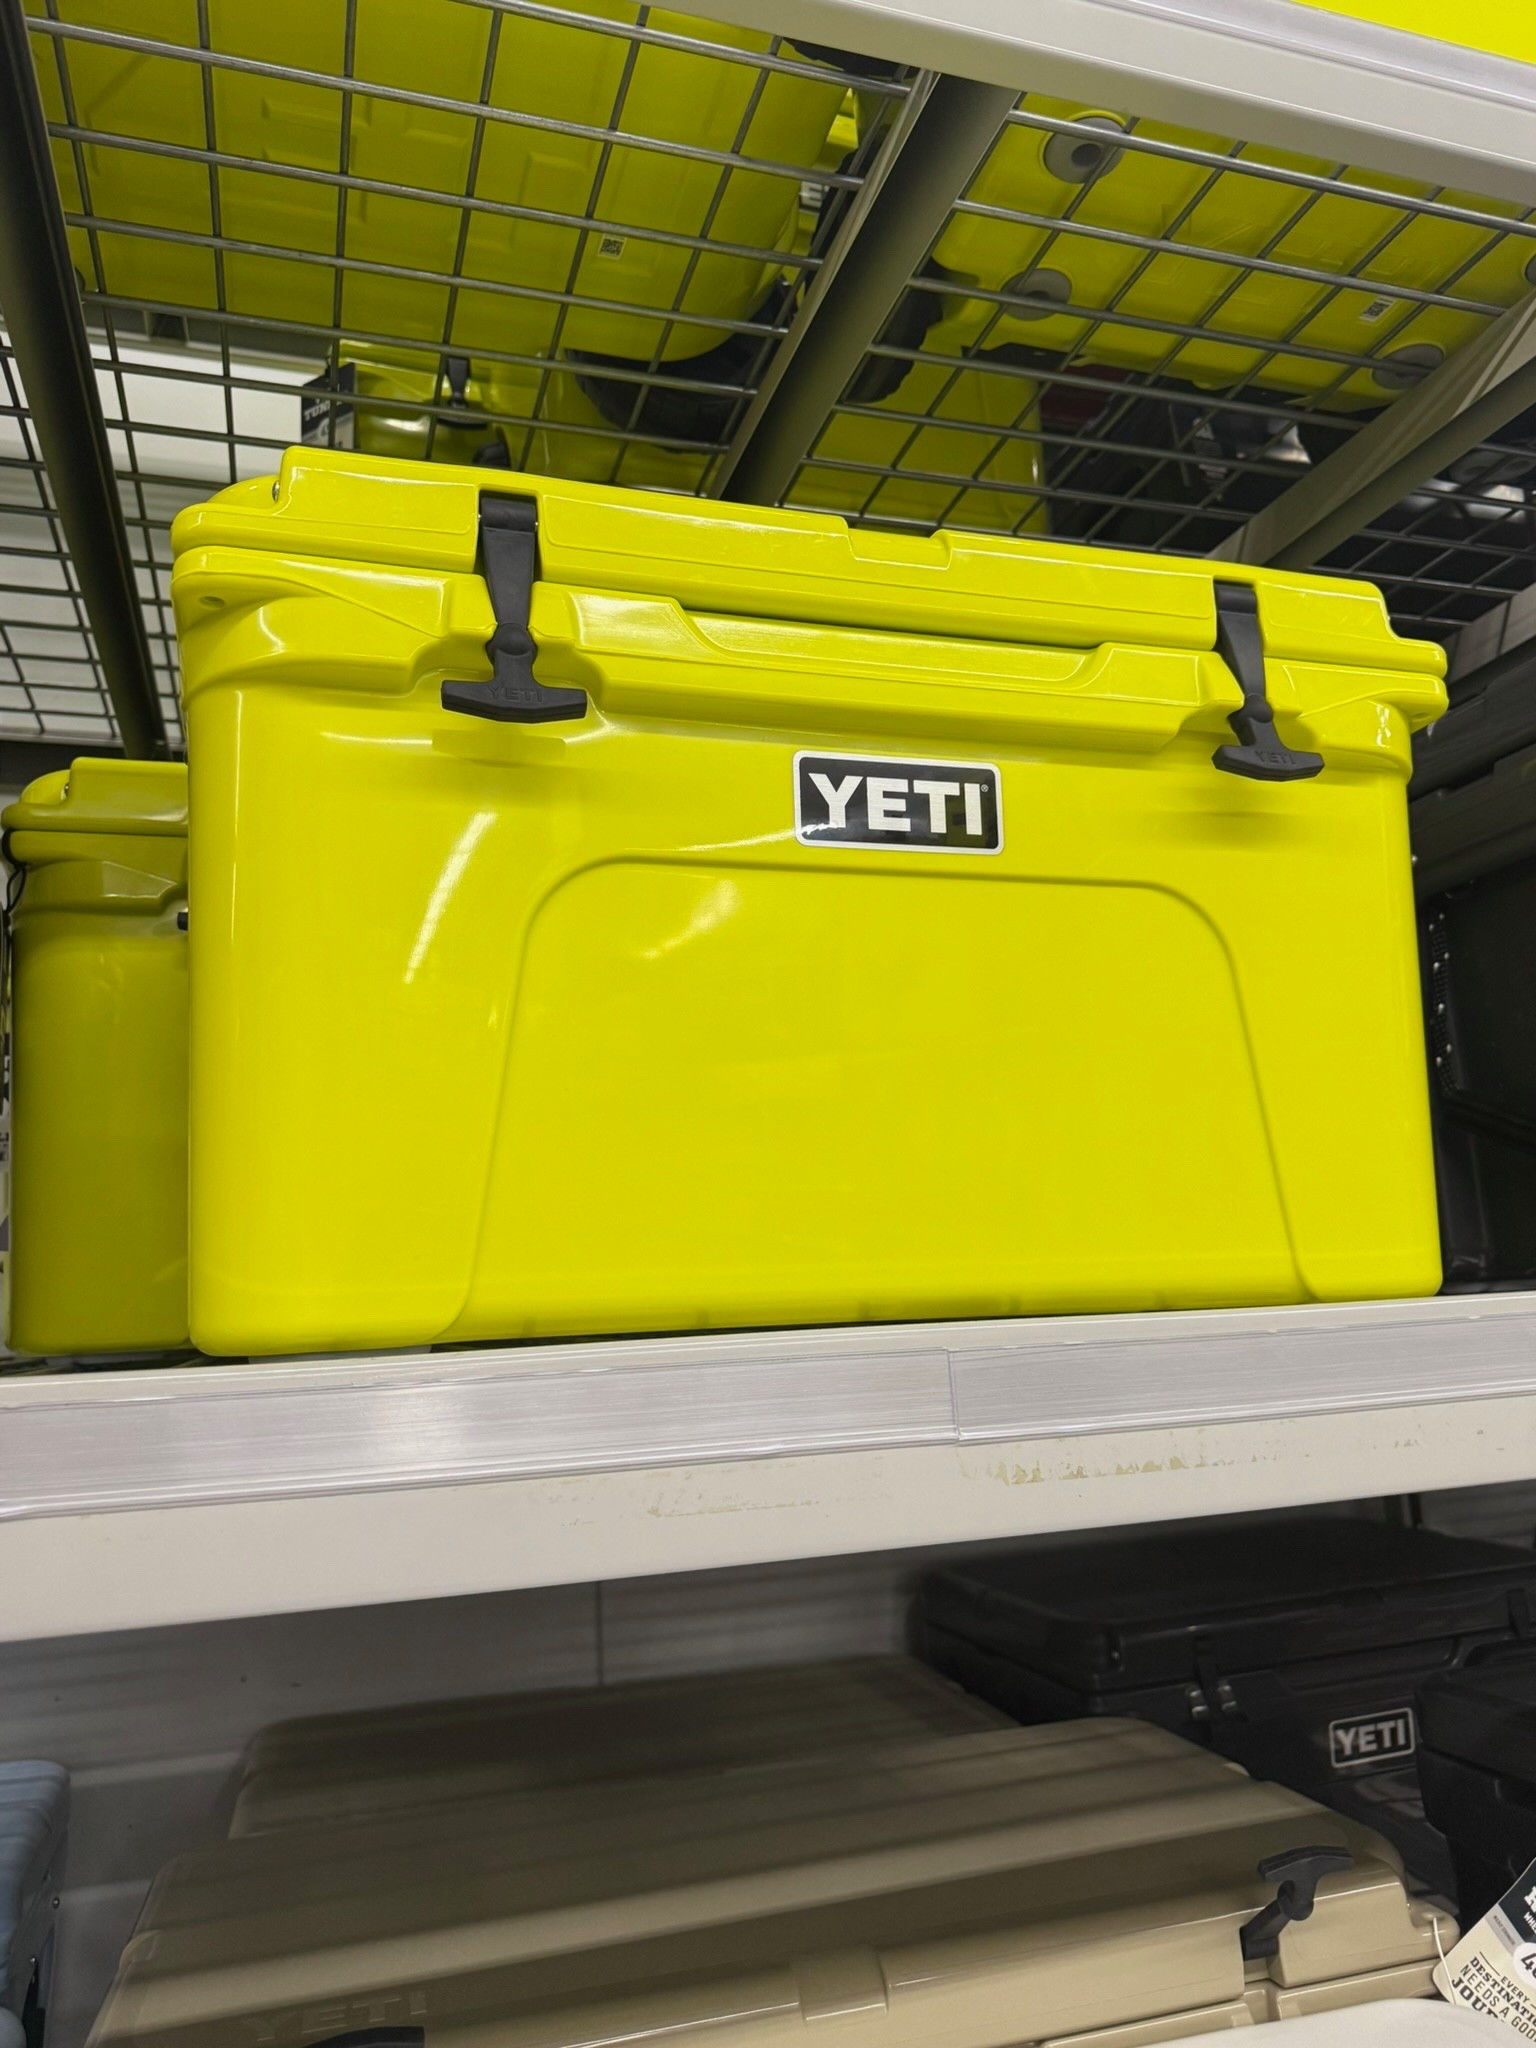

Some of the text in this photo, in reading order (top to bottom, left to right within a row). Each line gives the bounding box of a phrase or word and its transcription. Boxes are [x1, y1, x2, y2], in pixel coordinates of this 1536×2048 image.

[486, 686, 543, 702] YETI
[1254, 750, 1296, 765] YETI
[808, 772, 983, 836] YETI
[1336, 1719, 1406, 1755] YETI
[1460, 1964, 1536, 2043] NEEDS A GOO
[1470, 1956, 1536, 2028] DESTINATIO
[1500, 1976, 1530, 2003] EVERY
[239, 1991, 429, 2042] YETI
